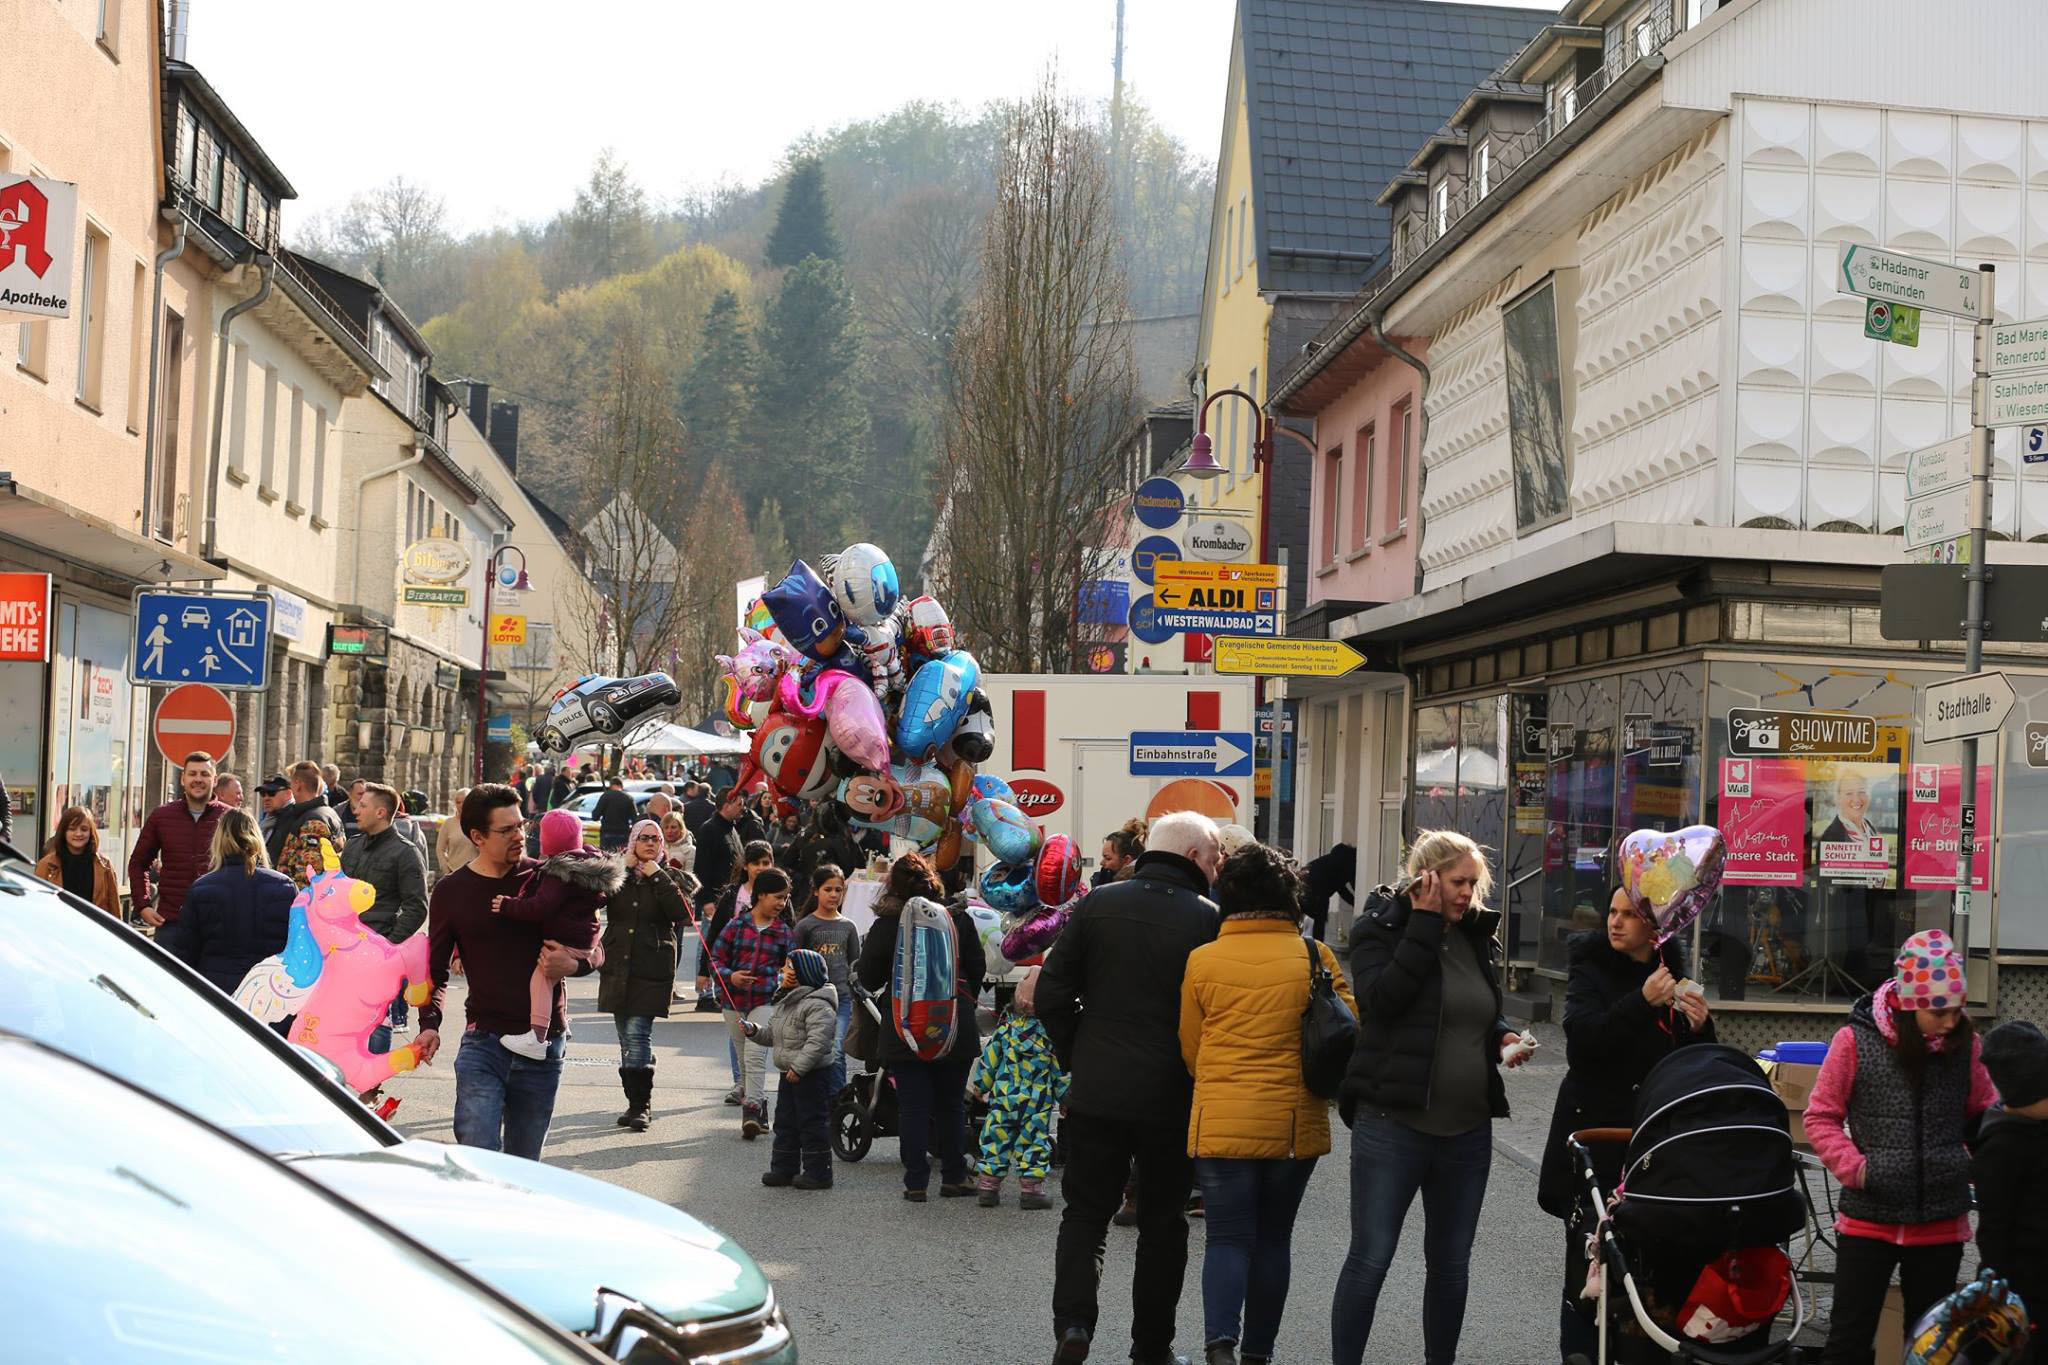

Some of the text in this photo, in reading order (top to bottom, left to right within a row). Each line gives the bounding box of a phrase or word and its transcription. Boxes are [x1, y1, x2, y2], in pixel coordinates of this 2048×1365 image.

[1881, 257, 1970, 290] Hadamar 20
[1868, 276, 1925, 300] Gemünden
[0, 288, 67, 309] Apotheke
[1996, 331, 2017, 346] Bad
[1995, 347, 2046, 366] Rennerod
[1192, 536, 1247, 551] Krombacher
[1187, 588, 1245, 608] ALDI
[1164, 614, 1254, 629] WESTERWALDBAD
[493, 633, 521, 643] LOTTO
[1218, 640, 1265, 649] Evangelische
[1266, 641, 1301, 650] Gemeinde
[1938, 693, 1991, 721] Stadthalle
[558, 710, 584, 726] POLICE
[1790, 718, 1871, 745] SHOWTIME
[1136, 748, 1217, 760] Einbahnstraße
[1911, 838, 1931, 851] für
[1765, 851, 1799, 862] Stadt.
